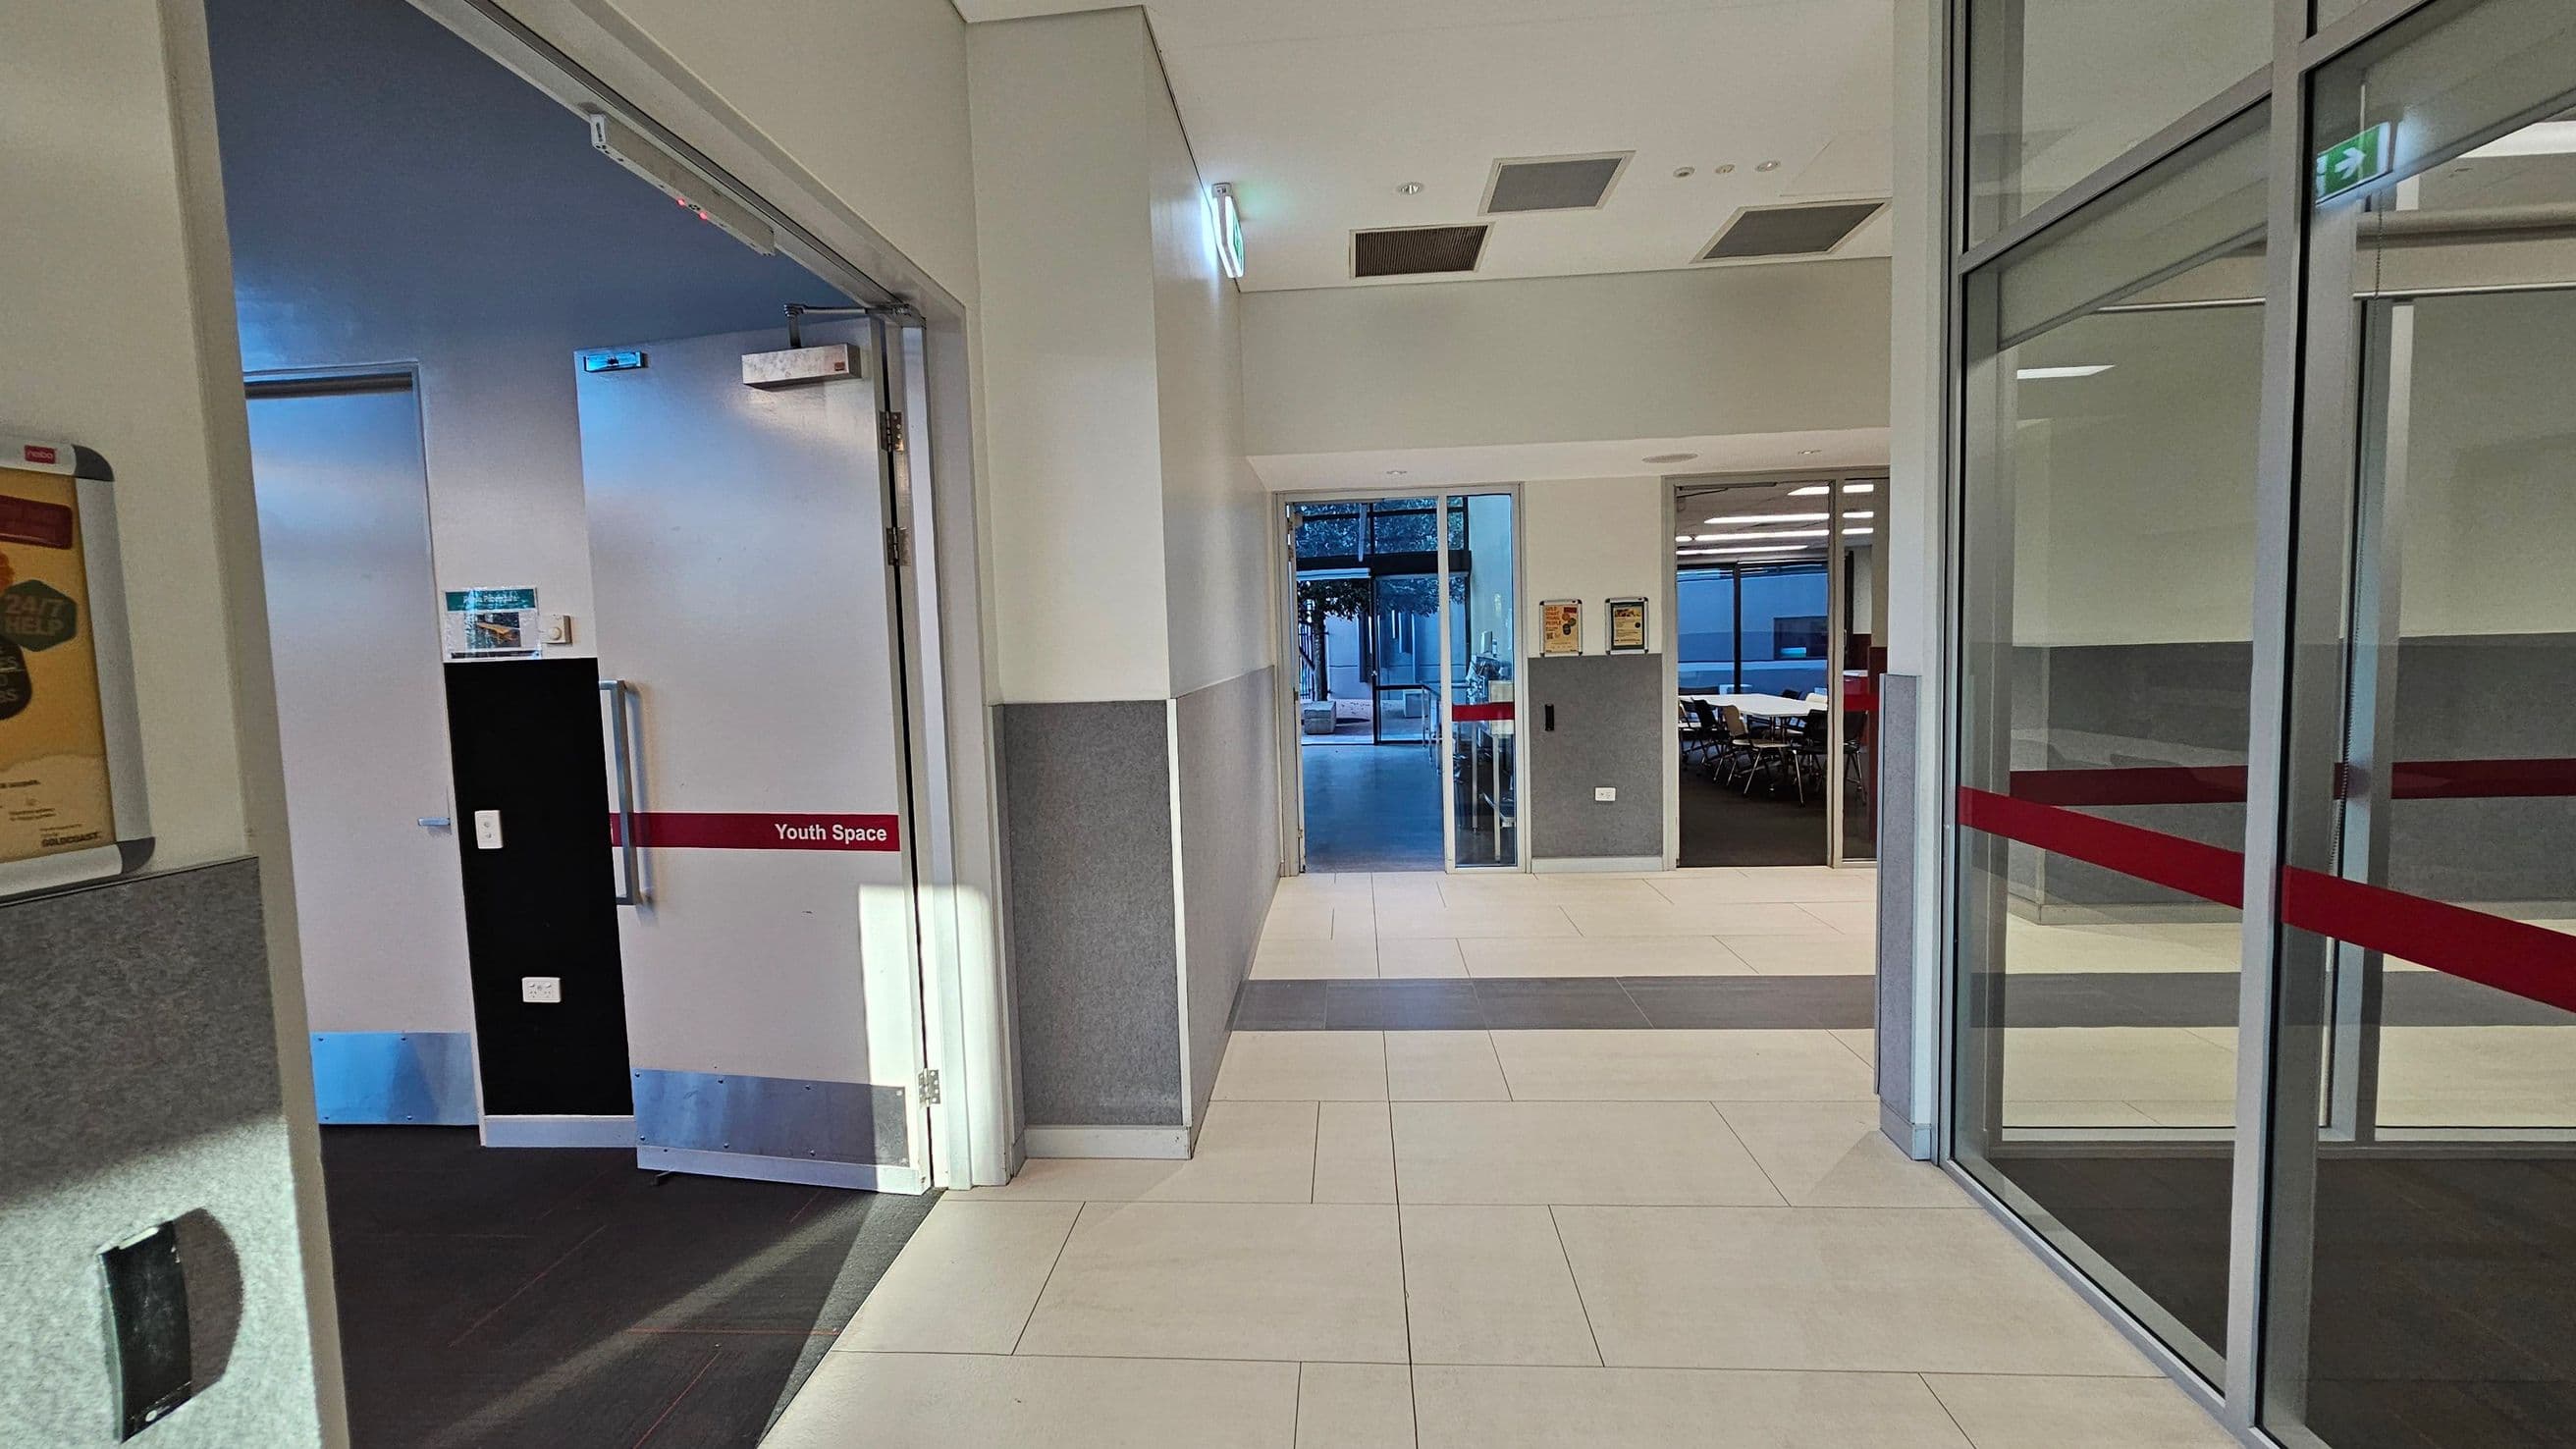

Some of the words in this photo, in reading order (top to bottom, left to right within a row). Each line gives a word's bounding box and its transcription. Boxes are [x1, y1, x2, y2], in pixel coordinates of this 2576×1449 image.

[5, 593, 65, 617] 24/7
[4, 615, 65, 636] HELP
[775, 824, 827, 840] Youth
[832, 824, 887, 844] Space
